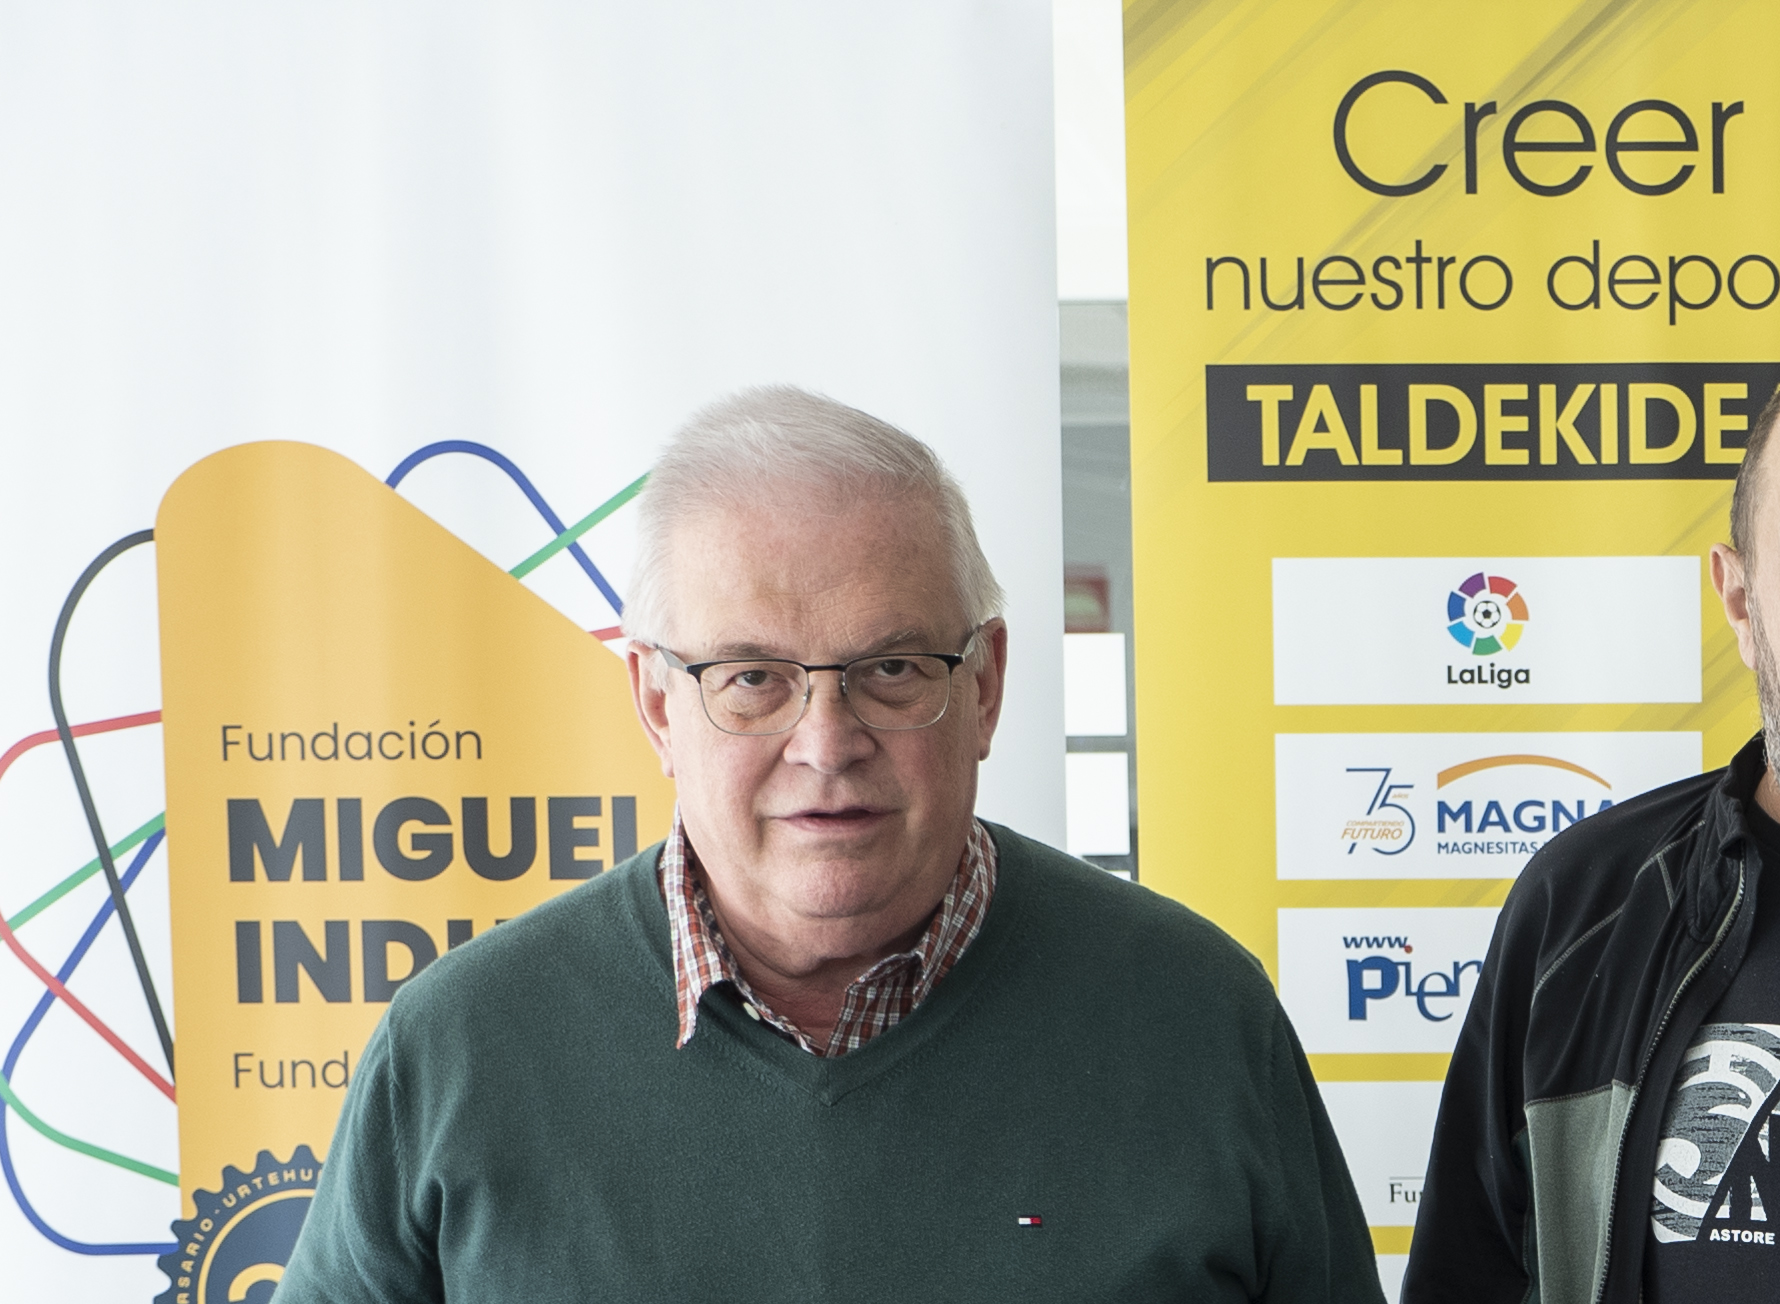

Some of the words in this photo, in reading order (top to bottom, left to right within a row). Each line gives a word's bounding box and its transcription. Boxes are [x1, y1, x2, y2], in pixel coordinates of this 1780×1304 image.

[1332, 70, 1745, 197] Creer
[1204, 240, 1513, 312] nuestro
[1447, 663, 1531, 690] LaLiga
[221, 720, 483, 762] Fundación
[1341, 828, 1403, 841] FUTURO
[233, 1052, 349, 1089] Fund
[1709, 1228, 1776, 1246] ASTORE
